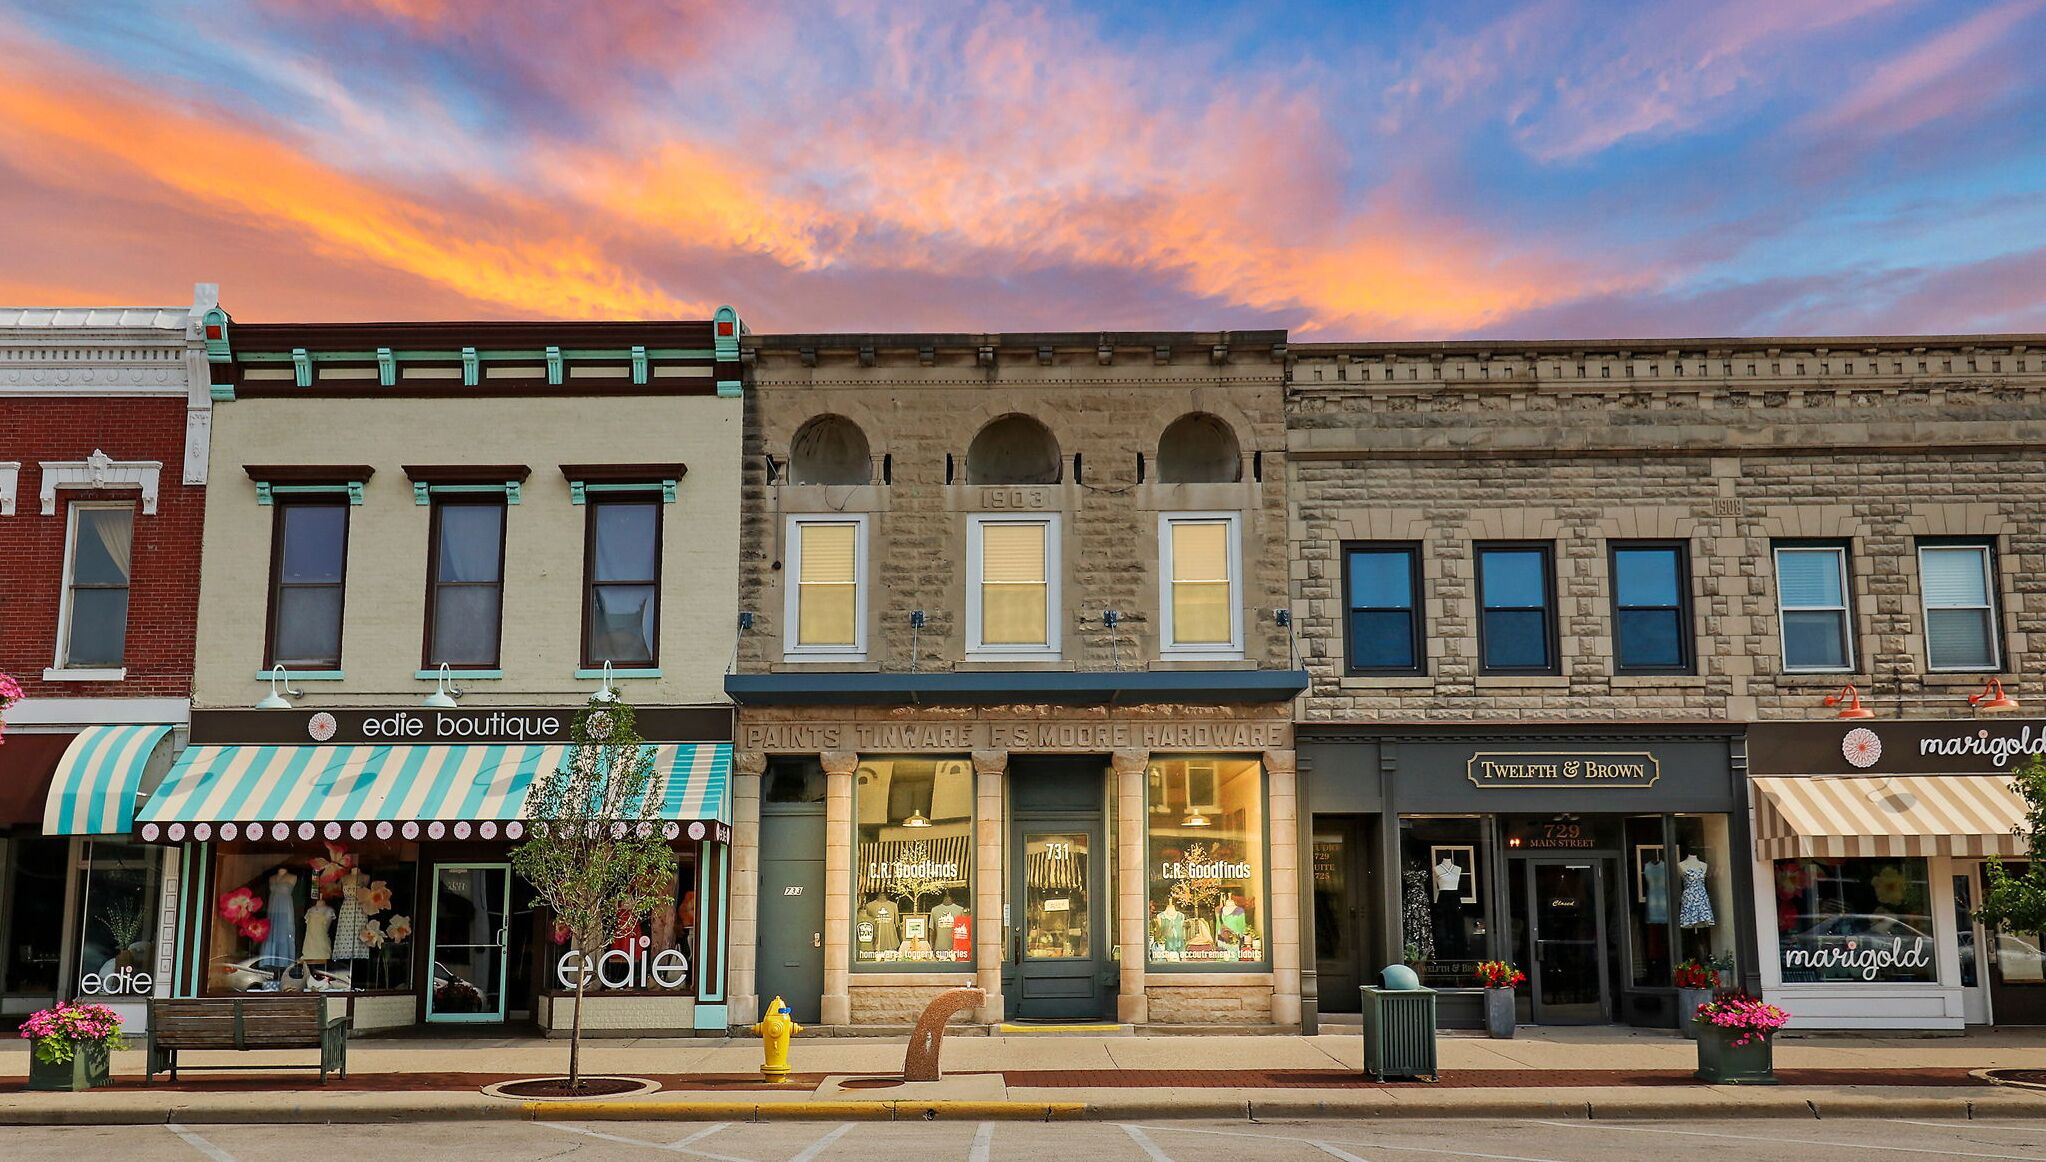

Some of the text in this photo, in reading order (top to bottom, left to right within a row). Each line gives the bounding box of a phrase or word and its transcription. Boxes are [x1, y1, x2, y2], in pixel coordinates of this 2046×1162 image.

[982, 488, 1044, 508] 1903
[1714, 499, 1742, 515] 1908
[362, 712, 560, 740] edie boutique
[746, 724, 841, 748] PAINTS
[856, 723, 973, 748] TINWARE
[1143, 723, 1284, 748] HARDWARE
[1920, 725, 2046, 767] marigold
[1481, 761, 1644, 778] TWELFTH & BROWN
[1544, 824, 1580, 838] 729
[1046, 843, 1069, 860] 731
[896, 860, 958, 879] Goodfinds
[1188, 861, 1251, 879] Goodfinds
[558, 935, 689, 988] edie
[936, 949, 968, 959] sundries
[1238, 949, 1262, 959] tidbits
[1785, 936, 1930, 981] marigold
[81, 965, 153, 994] edie
